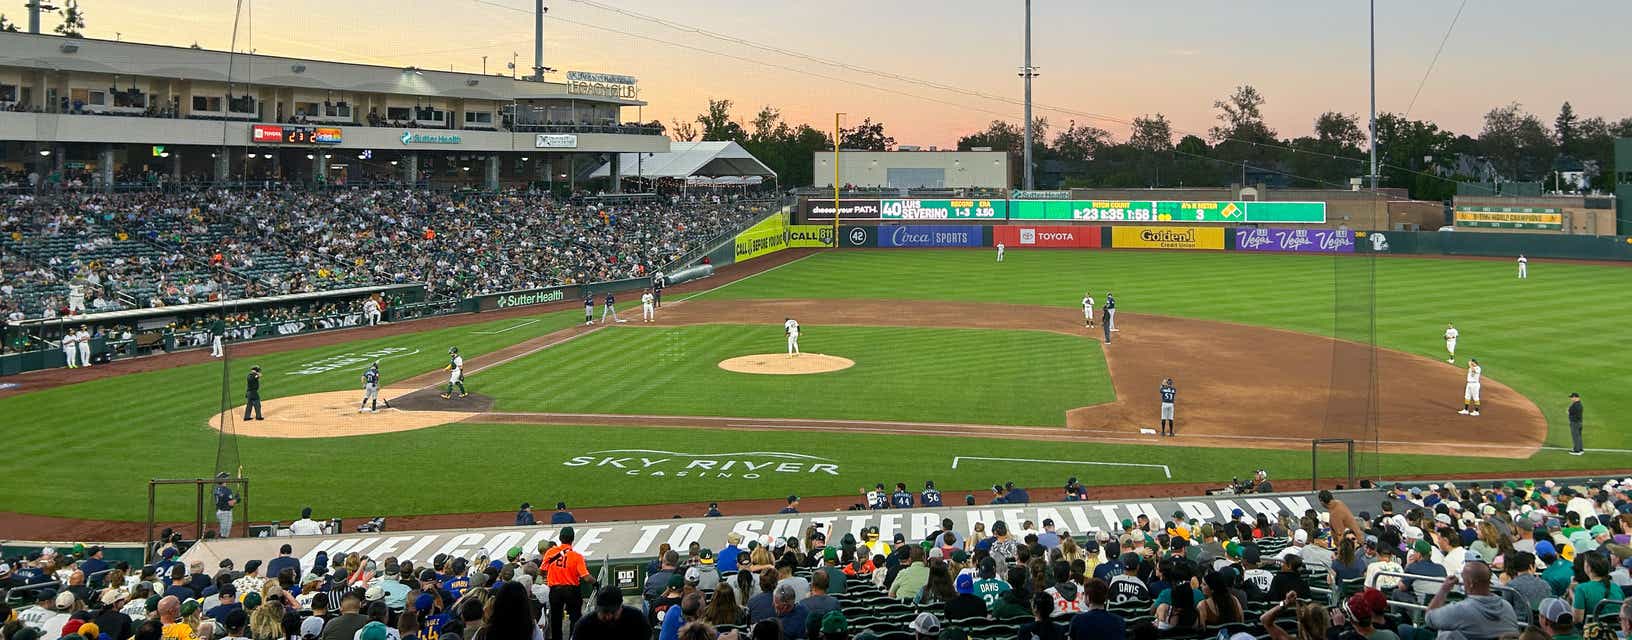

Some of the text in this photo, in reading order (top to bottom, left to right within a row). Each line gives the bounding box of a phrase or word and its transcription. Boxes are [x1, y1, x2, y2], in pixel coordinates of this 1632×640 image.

[610, 84, 635, 98] CLUB
[883, 202, 901, 217] 40
[902, 200, 921, 209] LUIS
[837, 207, 854, 215] your
[902, 208, 948, 219] SEVERINO
[955, 208, 970, 217] 1-3
[976, 208, 994, 217] 3.50
[1196, 209, 1204, 220] 3
[791, 232, 818, 240] CALL
[852, 231, 863, 241] 42
[892, 226, 968, 247] Circa SPORTS
[1038, 232, 1074, 240] TOYOTA
[1236, 230, 1353, 250] Vegas Vegas Vegas
[736, 241, 748, 256] CALL
[507, 289, 564, 307] Sutter Health
[563, 456, 840, 475] SKY RIVER
[626, 469, 761, 479] CASINO
[927, 493, 940, 503] 56
[629, 522, 707, 554] TO
[966, 503, 1167, 541] HEALTH
[1178, 496, 1323, 527] PARK
[980, 583, 999, 592] DAVIS
[1118, 582, 1140, 595] DAVIS
